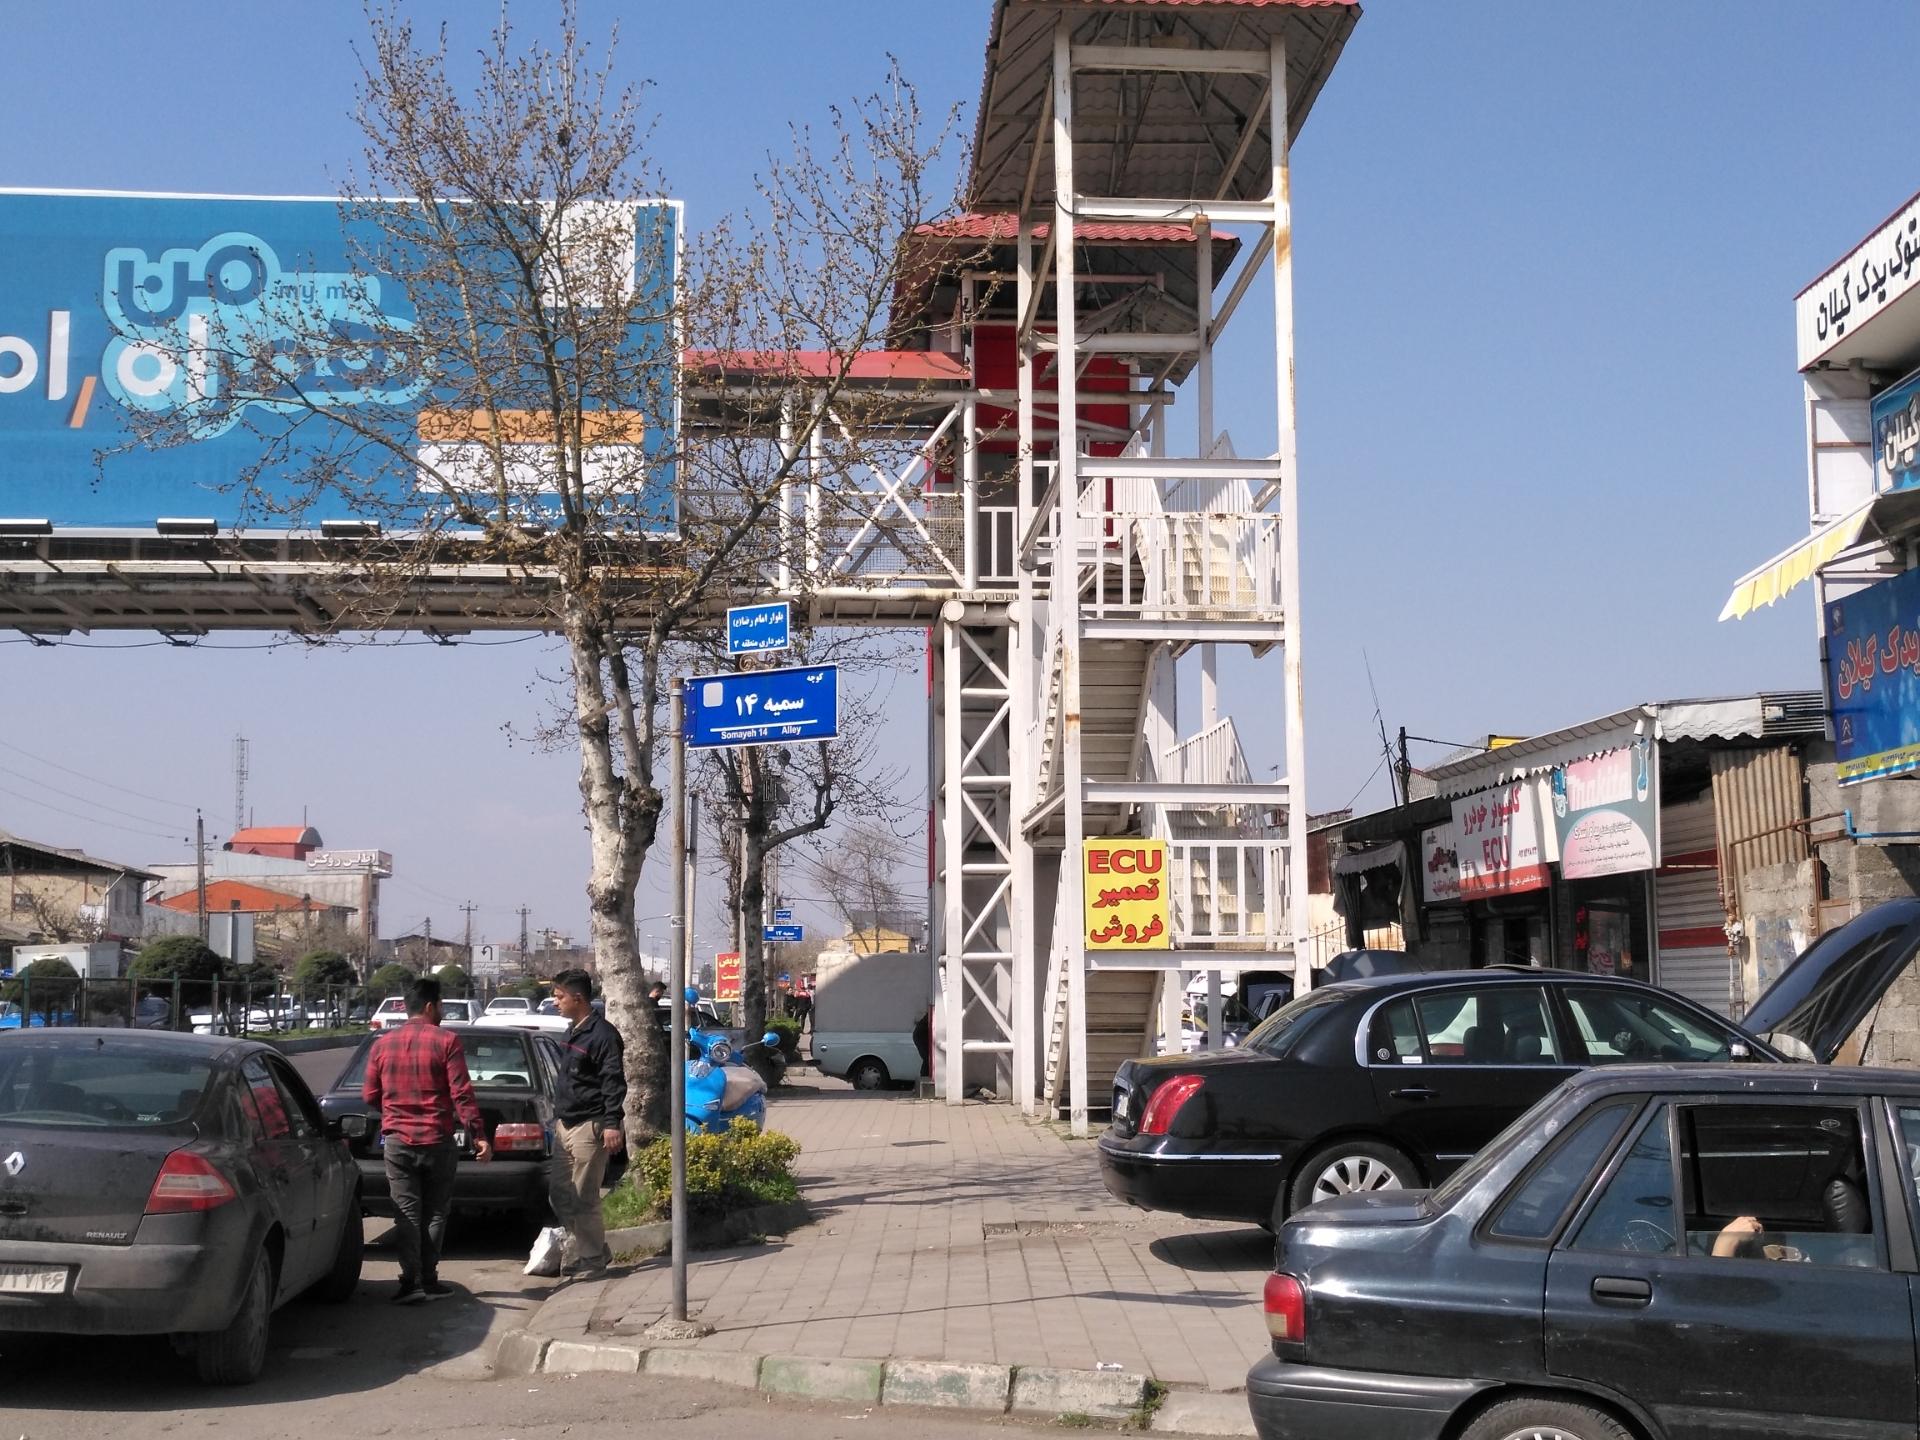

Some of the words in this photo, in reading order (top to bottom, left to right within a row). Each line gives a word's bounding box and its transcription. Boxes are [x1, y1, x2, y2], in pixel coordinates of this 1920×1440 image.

[1889, 217, 1920, 281] توک
[1857, 258, 1887, 304] یدک
[1817, 270, 1851, 341] گیلان
[754, 612, 768, 627] امام
[768, 611, 784, 624] بلوار
[741, 639, 758, 647] منطقه
[758, 636, 785, 648] شهرداری
[1838, 633, 1877, 700] گیلان
[806, 672, 824, 683] کوچه
[735, 693, 758, 716] ۱۴
[763, 697, 804, 716] سمیه
[721, 729, 757, 741] Somayeh
[758, 728, 768, 737] 14
[781, 726, 802, 736] Alley
[1463, 797, 1487, 836] خودرو
[308, 853, 341, 868] روکش
[343, 852, 376, 867] اطلس
[1088, 849, 1162, 874] ECU
[1482, 835, 1510, 871] ECU
[1091, 878, 1160, 908] تعمیر
[1090, 913, 1164, 944] فروش
[86, 1231, 128, 1240] RENAULT
